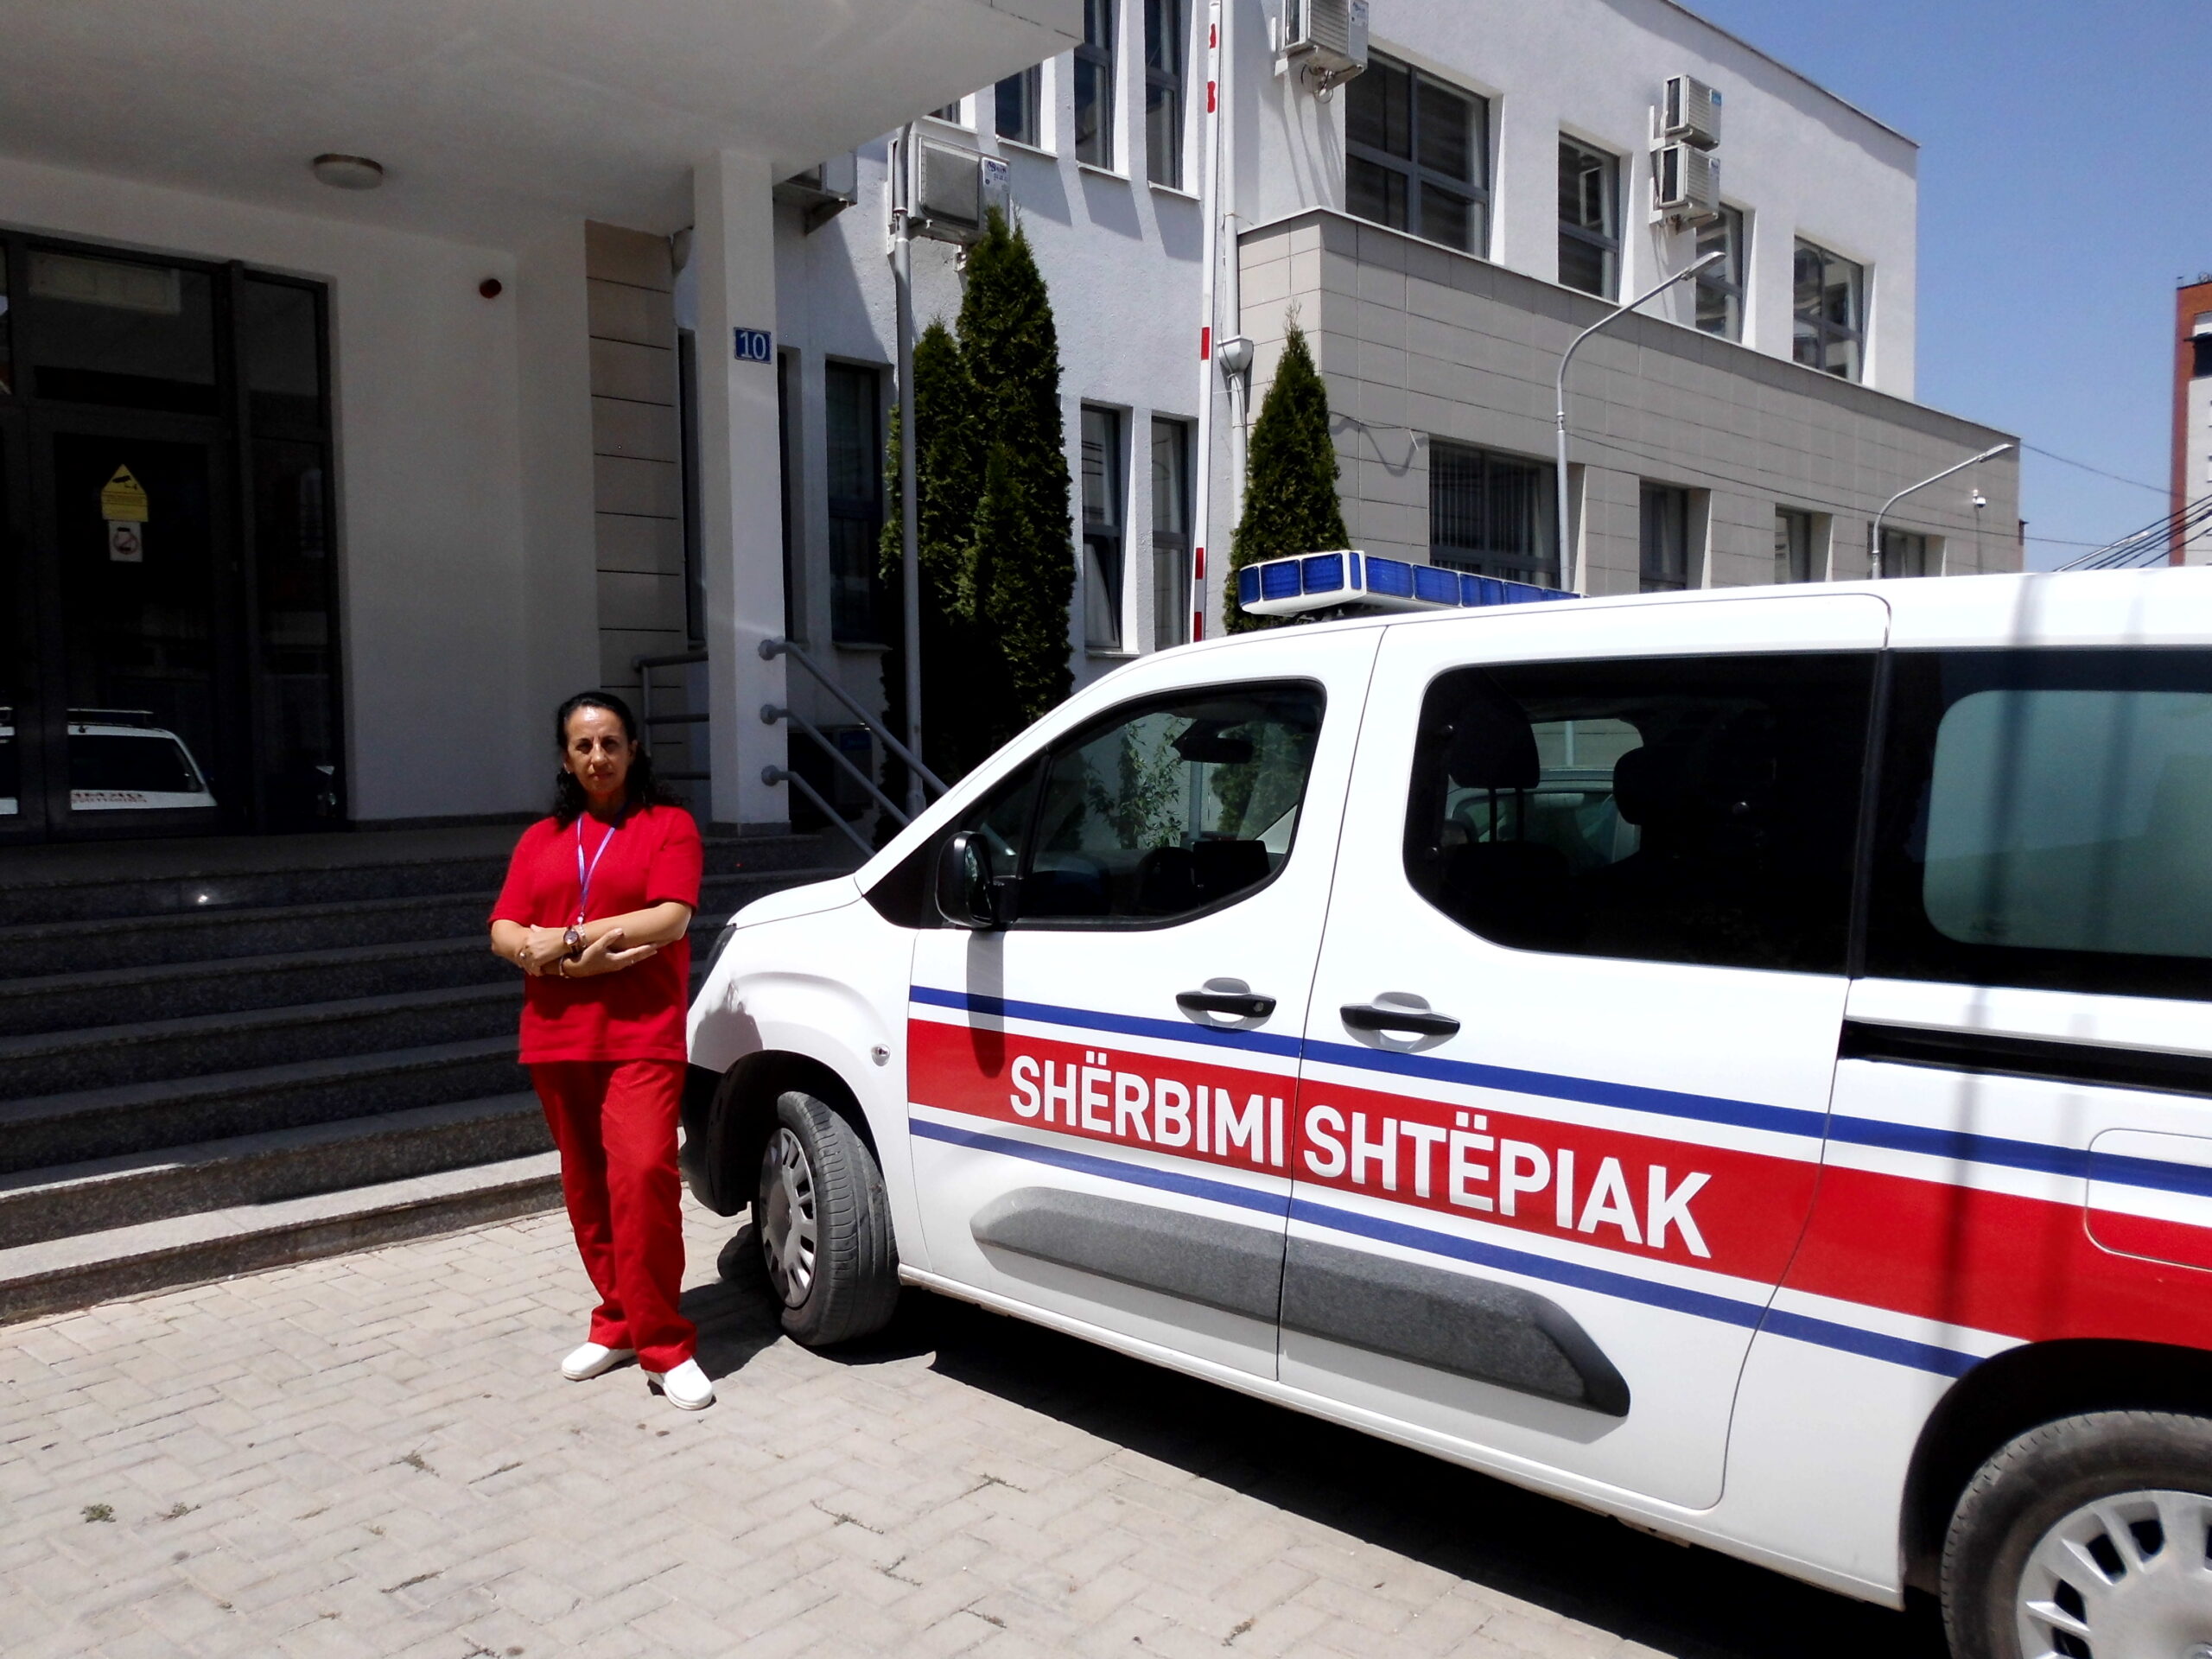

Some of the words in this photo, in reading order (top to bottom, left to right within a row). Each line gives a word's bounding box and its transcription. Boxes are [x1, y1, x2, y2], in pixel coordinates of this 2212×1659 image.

[741, 332, 766, 360] 10
[1009, 1052, 1284, 1167] SHËRBIMI
[1303, 1105, 1713, 1258] SHTËPIAK
